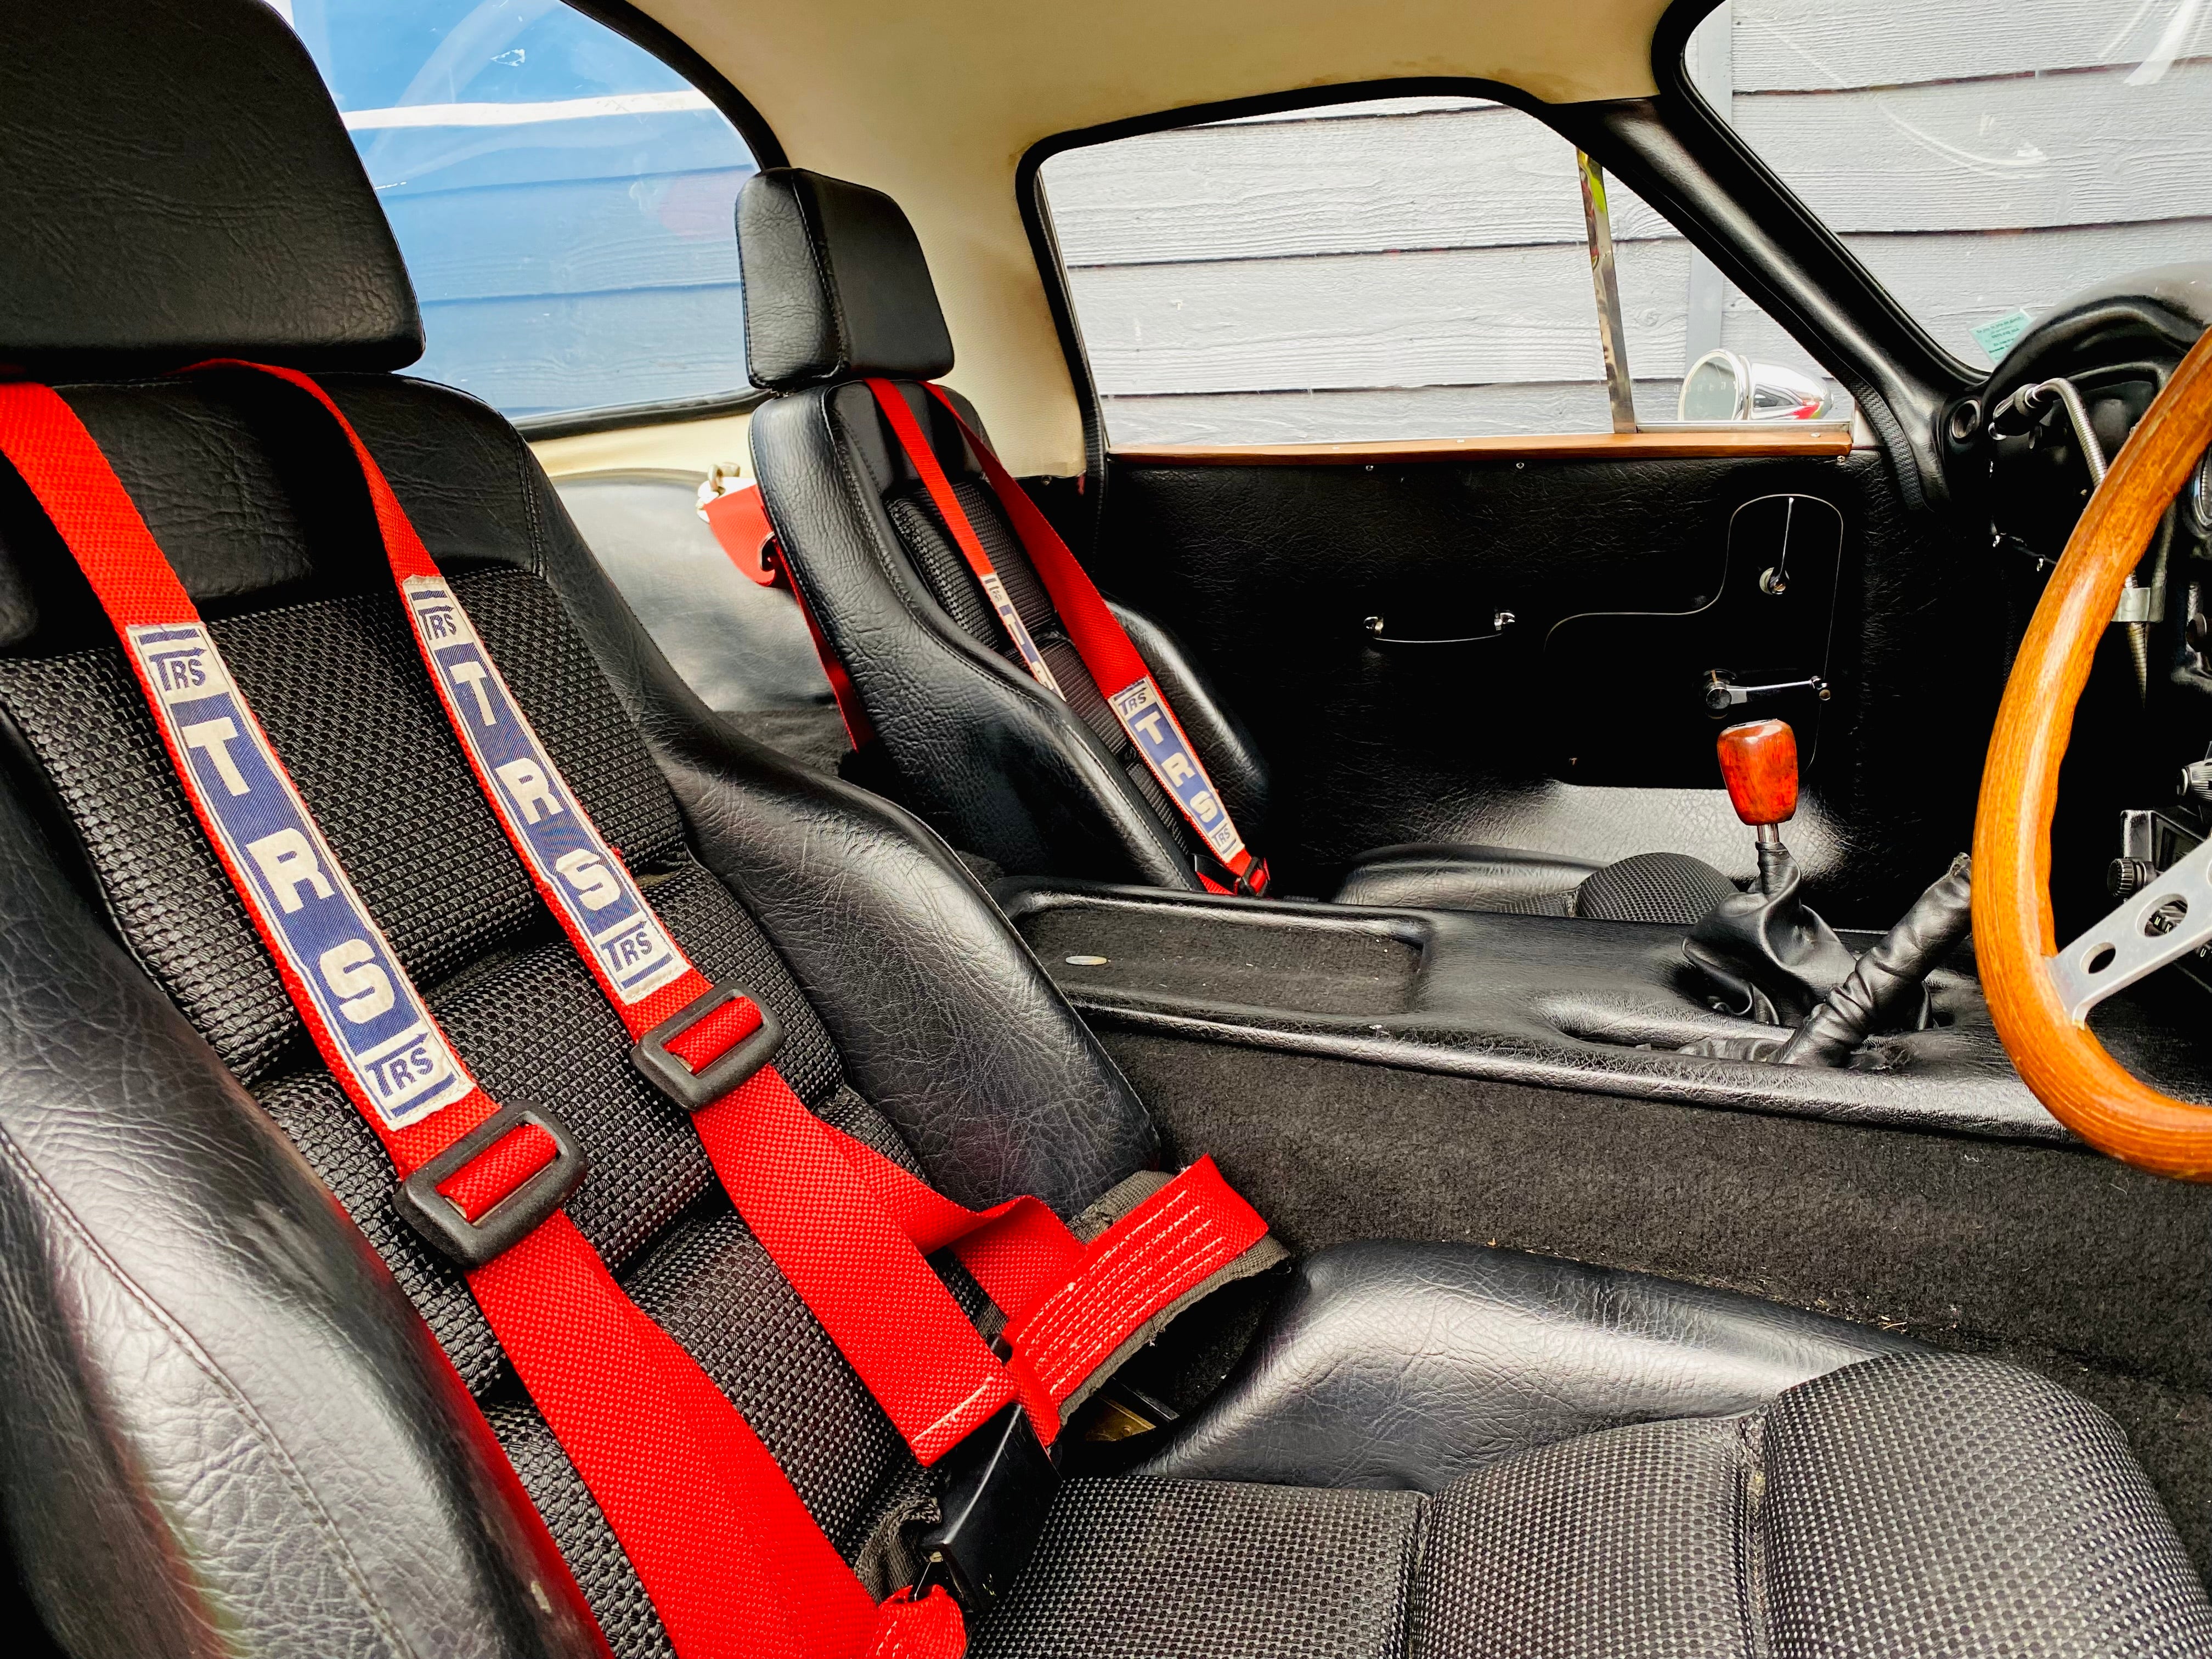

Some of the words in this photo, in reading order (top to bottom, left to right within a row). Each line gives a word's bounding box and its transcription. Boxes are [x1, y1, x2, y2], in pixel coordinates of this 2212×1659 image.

[418, 606, 457, 641] TRS
[149, 647, 207, 691] TRS
[1118, 687, 1147, 714] TRS
[449, 661, 621, 911] TRS
[1135, 711, 1218, 822] TRS
[1211, 823, 1231, 847] TRS
[182, 716, 395, 1024] TRS
[601, 921, 652, 972] TRS
[2200, 947, 2207, 957] U
[365, 1033, 433, 1098] TRS
